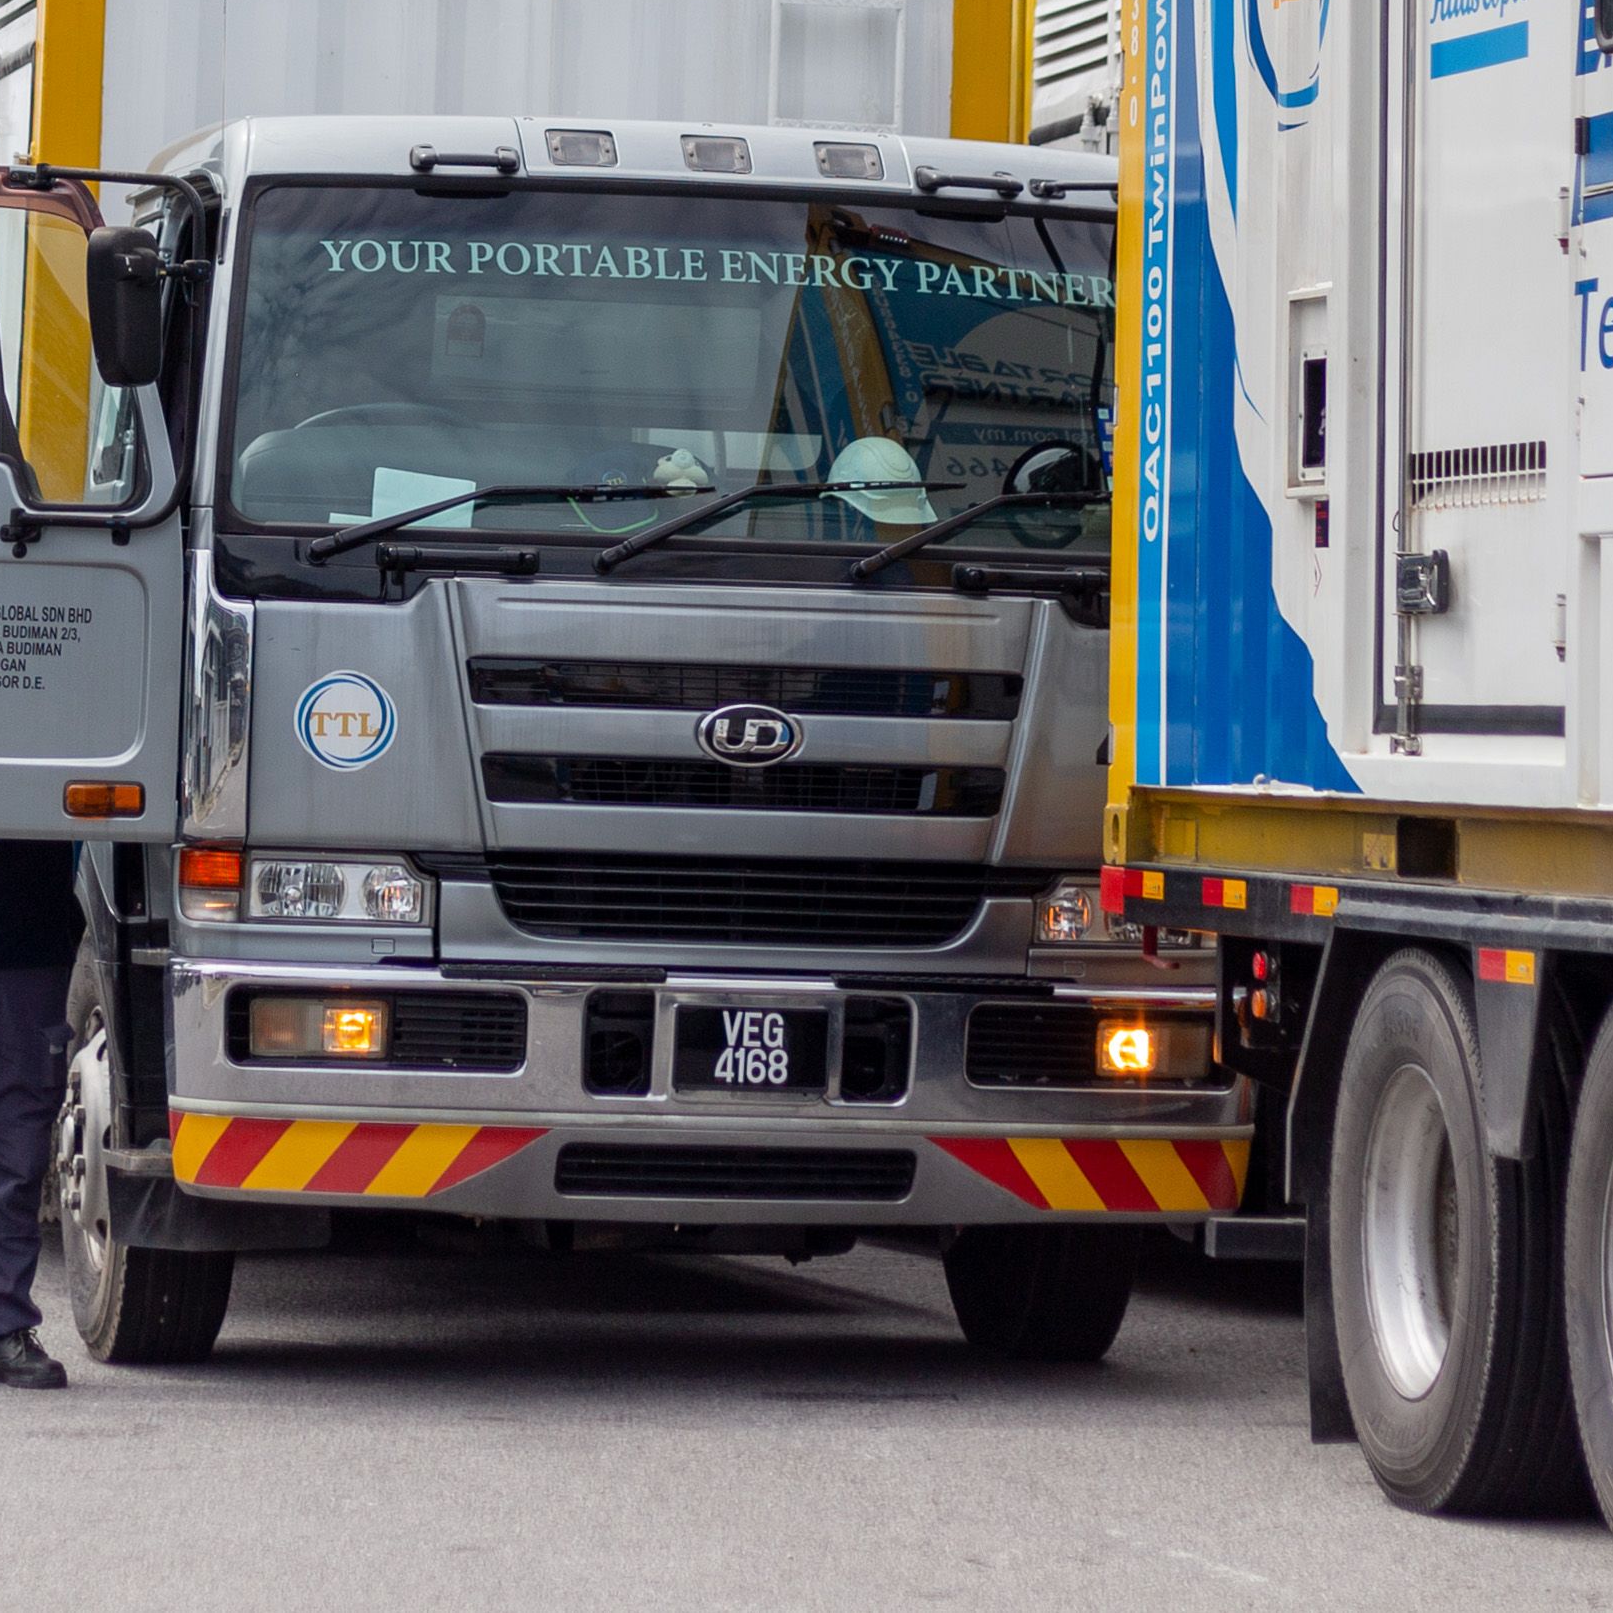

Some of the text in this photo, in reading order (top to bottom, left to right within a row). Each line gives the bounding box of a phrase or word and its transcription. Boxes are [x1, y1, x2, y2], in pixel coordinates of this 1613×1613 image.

[320, 240, 1116, 308] YOUR PORTABLE ENERGY PARTNER
[1143, 266, 1163, 542] QAC1100
[41, 606, 65, 623] SDN
[68, 608, 92, 624] BHD
[2, 625, 58, 640] BUDIMAN
[7, 641, 62, 656] BUDIMAN
[22, 675, 46, 690] D.E.
[310, 712, 381, 737] TTL
[712, 719, 790, 753] UD
[722, 1010, 784, 1048] VEG
[714, 1047, 789, 1084] 4168
